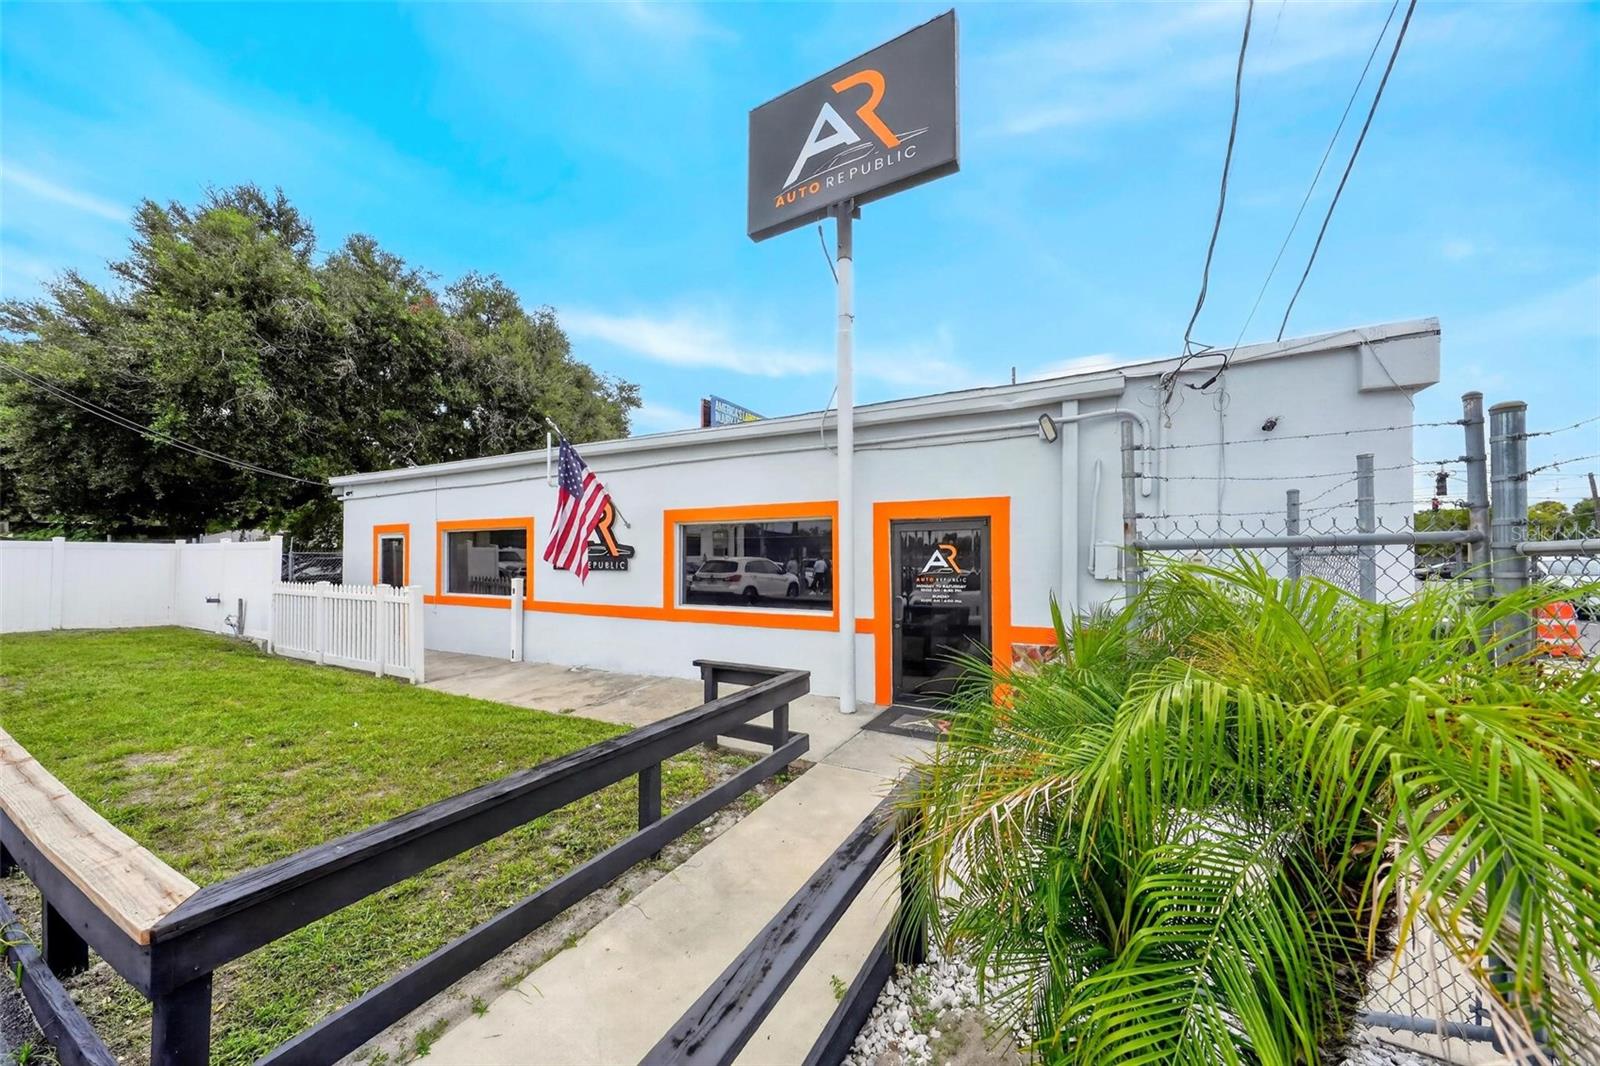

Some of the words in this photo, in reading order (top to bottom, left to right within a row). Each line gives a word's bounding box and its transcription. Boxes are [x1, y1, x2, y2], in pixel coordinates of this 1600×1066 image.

[782, 69, 901, 190] AR
[775, 182, 820, 208] AUTO
[826, 145, 917, 188] REPUBLIC
[587, 561, 625, 569] EPUBLIC
[921, 544, 961, 573] AR
